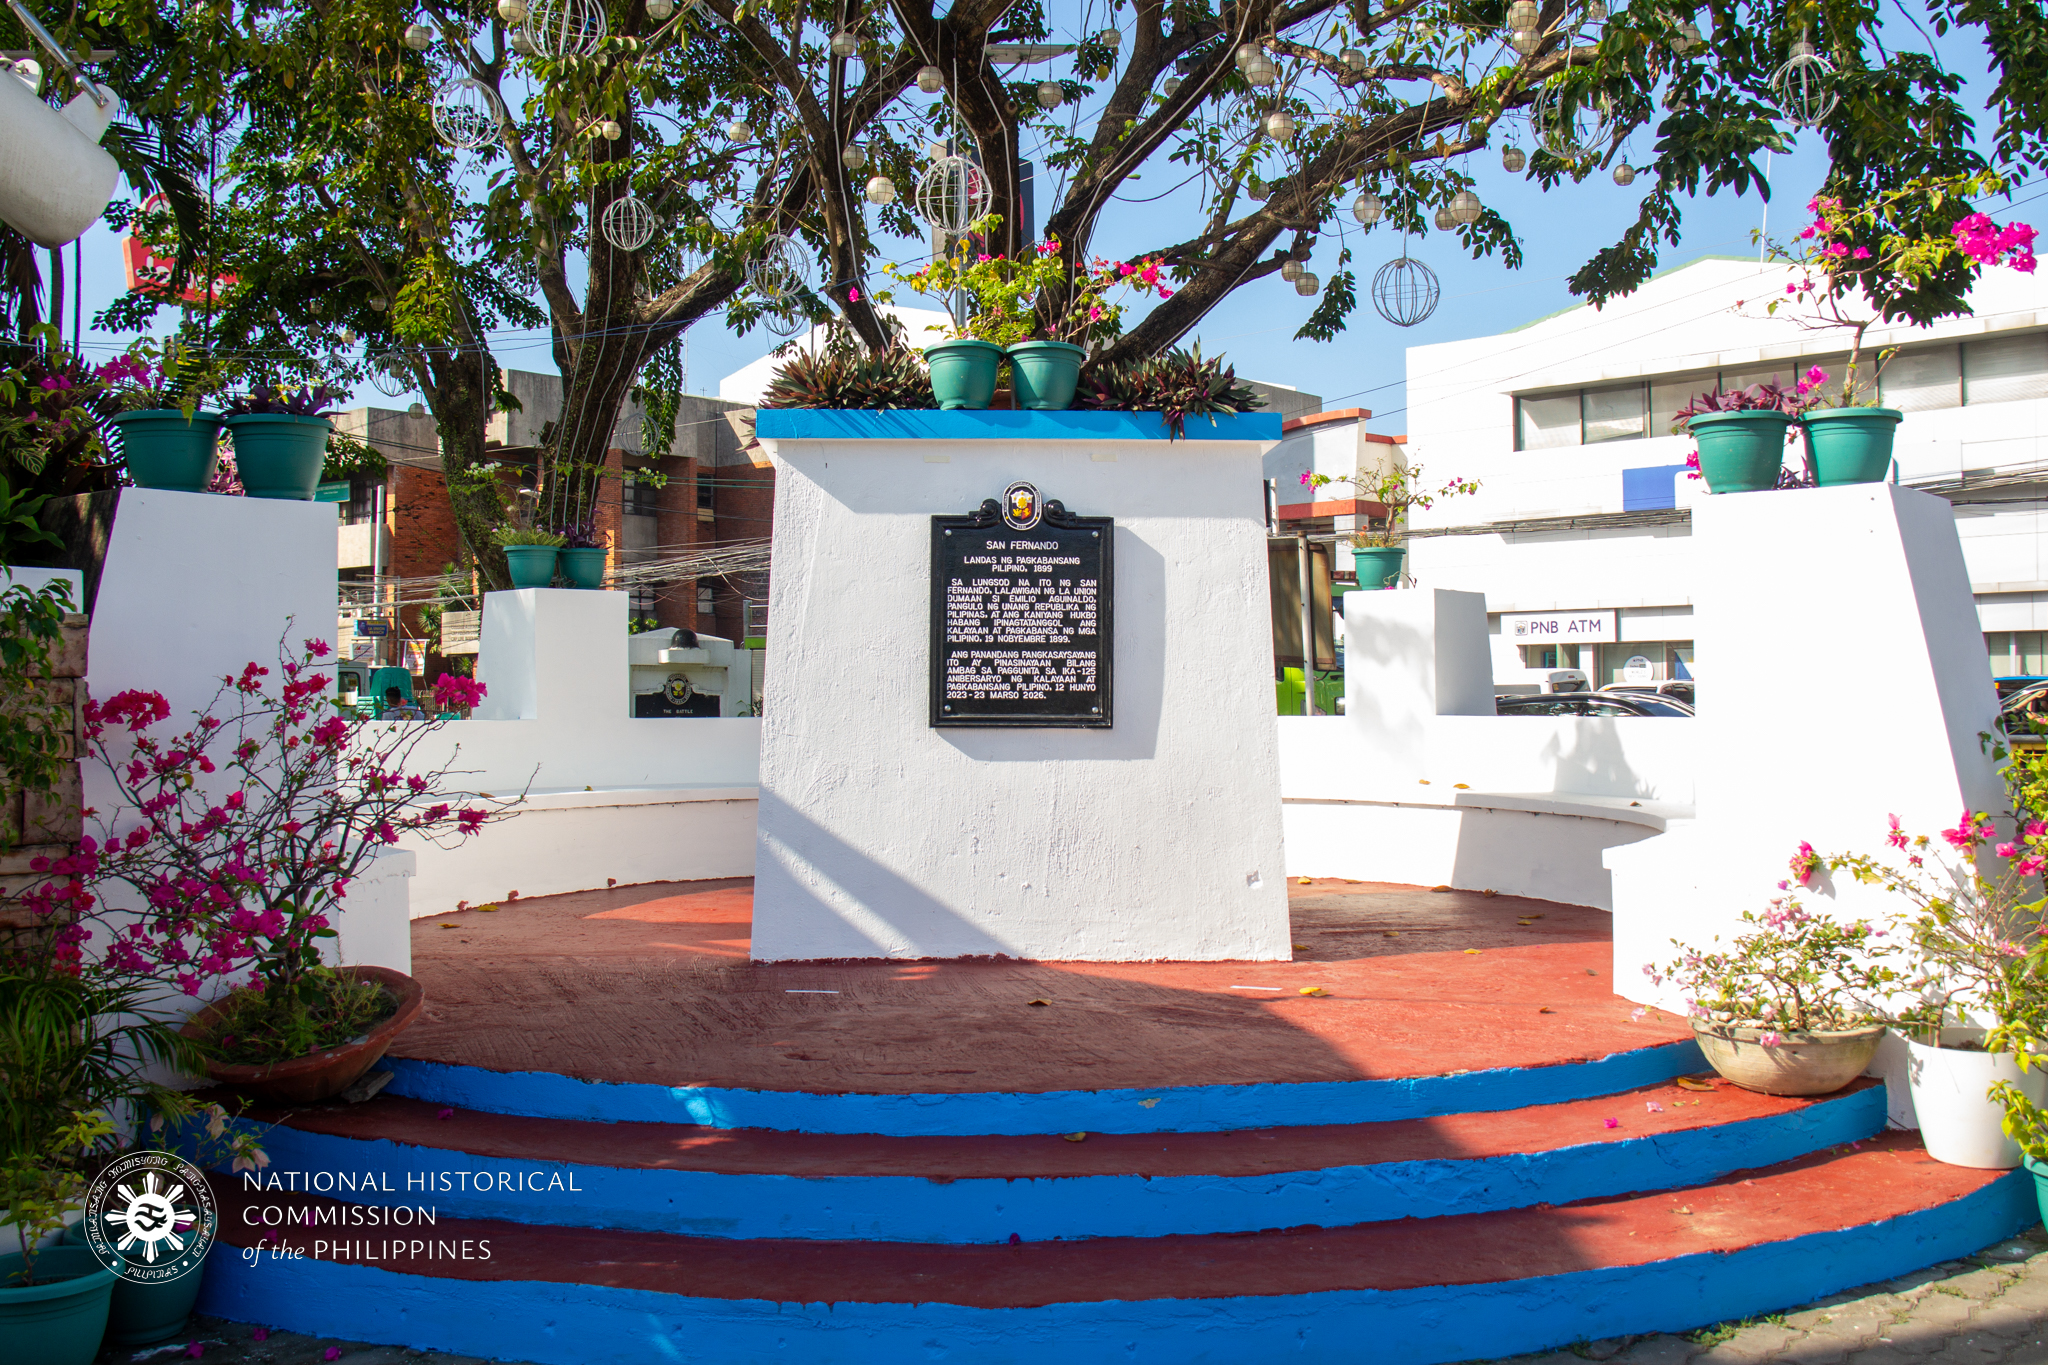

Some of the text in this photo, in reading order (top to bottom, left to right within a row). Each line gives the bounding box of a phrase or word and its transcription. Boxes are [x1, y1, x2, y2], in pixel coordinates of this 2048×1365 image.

[986, 541, 1059, 549] SAN FERNANDO
[964, 556, 997, 564] LANDAS
[1530, 619, 1601, 634] PNB ATM
[1049, 635, 1071, 643] 1899.
[1066, 659, 1096, 667] BILANG
[1023, 691, 1047, 699] 2026.
